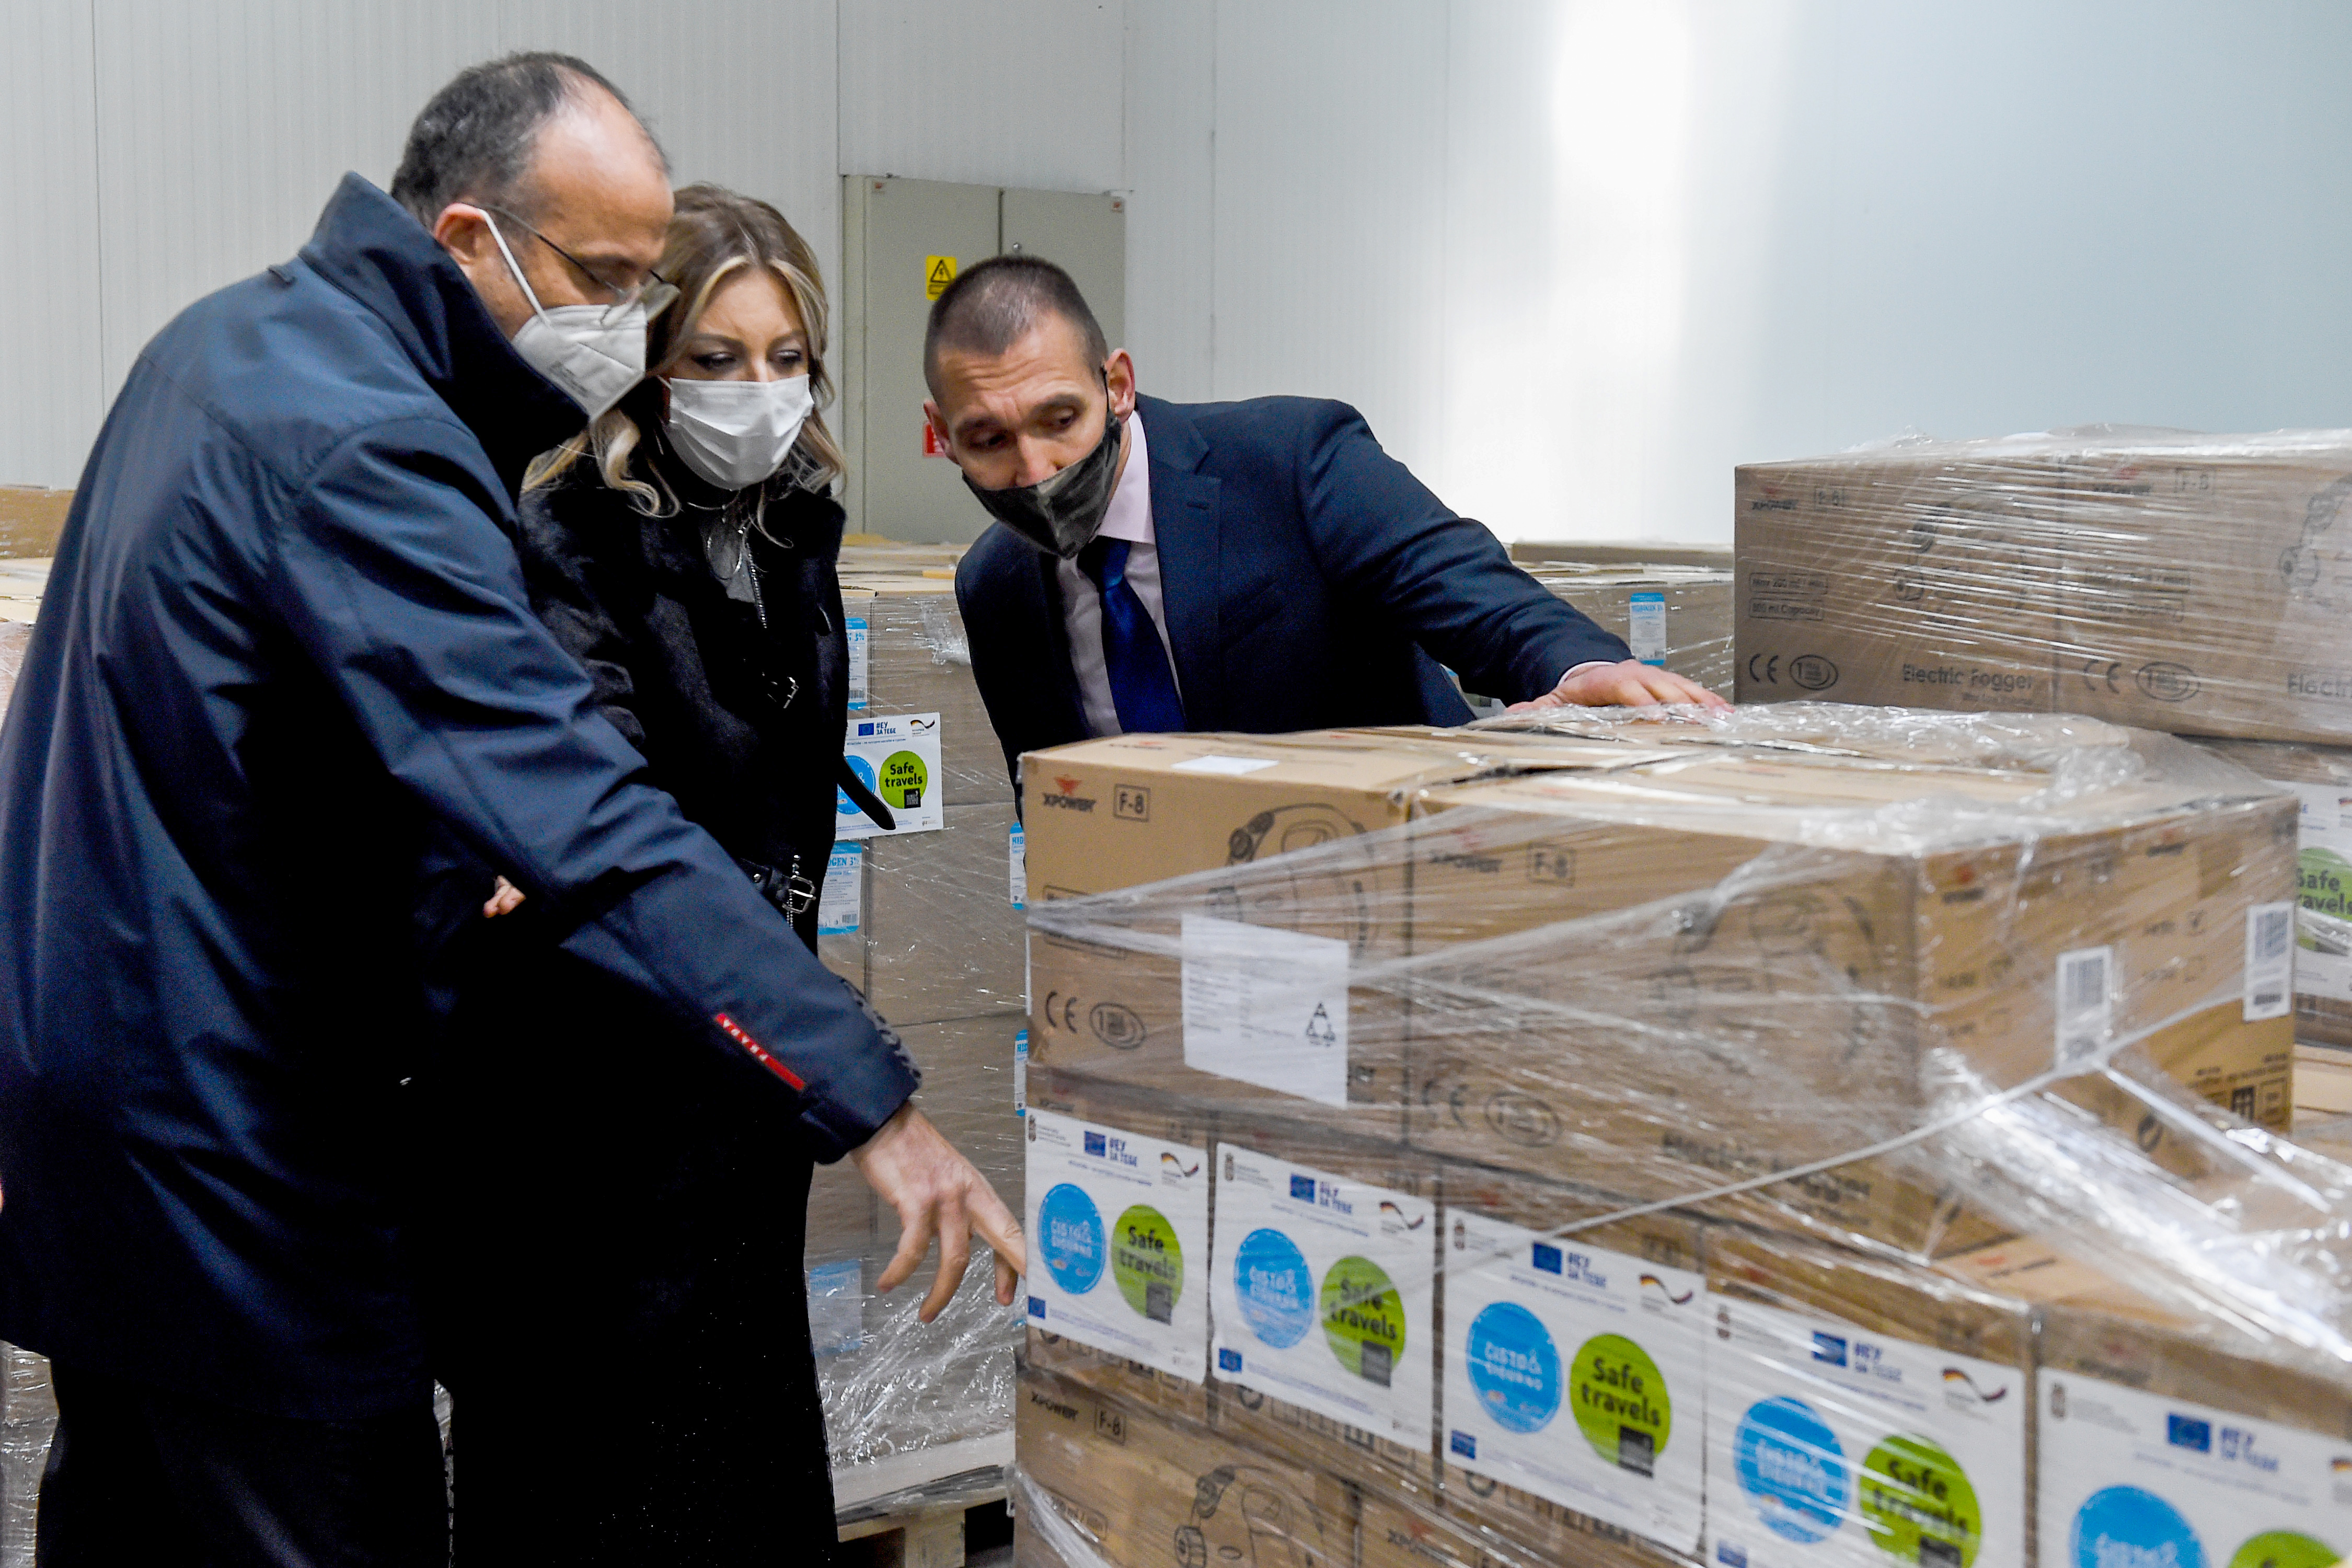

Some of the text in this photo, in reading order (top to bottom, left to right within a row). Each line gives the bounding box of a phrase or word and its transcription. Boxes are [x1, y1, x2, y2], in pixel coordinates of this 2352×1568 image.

[885, 774, 923, 787] travels
[890, 762, 914, 775] Safe
[1120, 791, 1145, 814] F-8
[1128, 1225, 1164, 1254] Safe
[1120, 1248, 1177, 1280] travels
[1340, 1278, 1383, 1310] Safe
[1329, 1300, 1397, 1339] travels
[1594, 1357, 1644, 1395] Safe
[1582, 1382, 1660, 1427] travels
